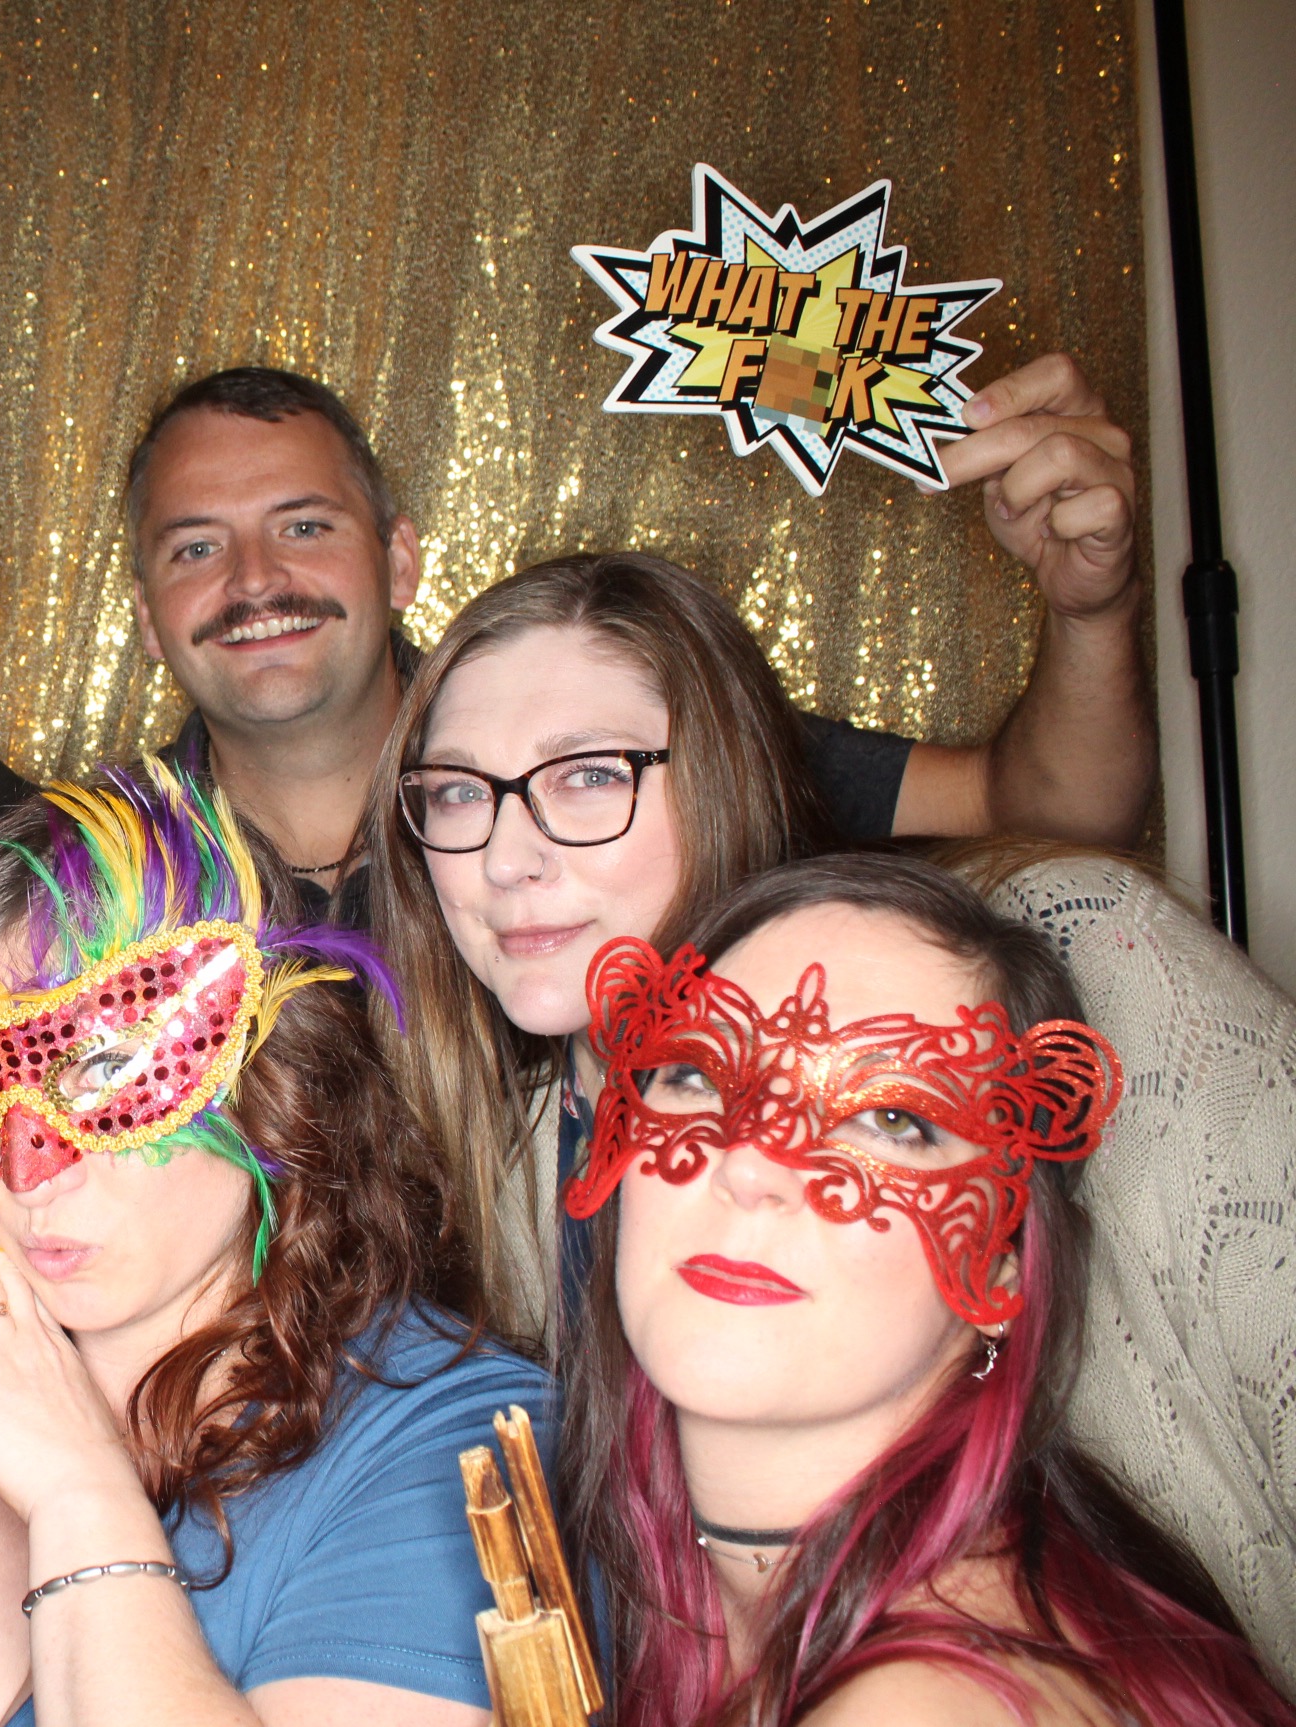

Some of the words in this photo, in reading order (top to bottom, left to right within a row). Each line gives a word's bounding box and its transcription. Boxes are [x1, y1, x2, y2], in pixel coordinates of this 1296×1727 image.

[644, 250, 816, 333] WHAT
[835, 287, 940, 358] THE
[717, 339, 884, 425] FK
